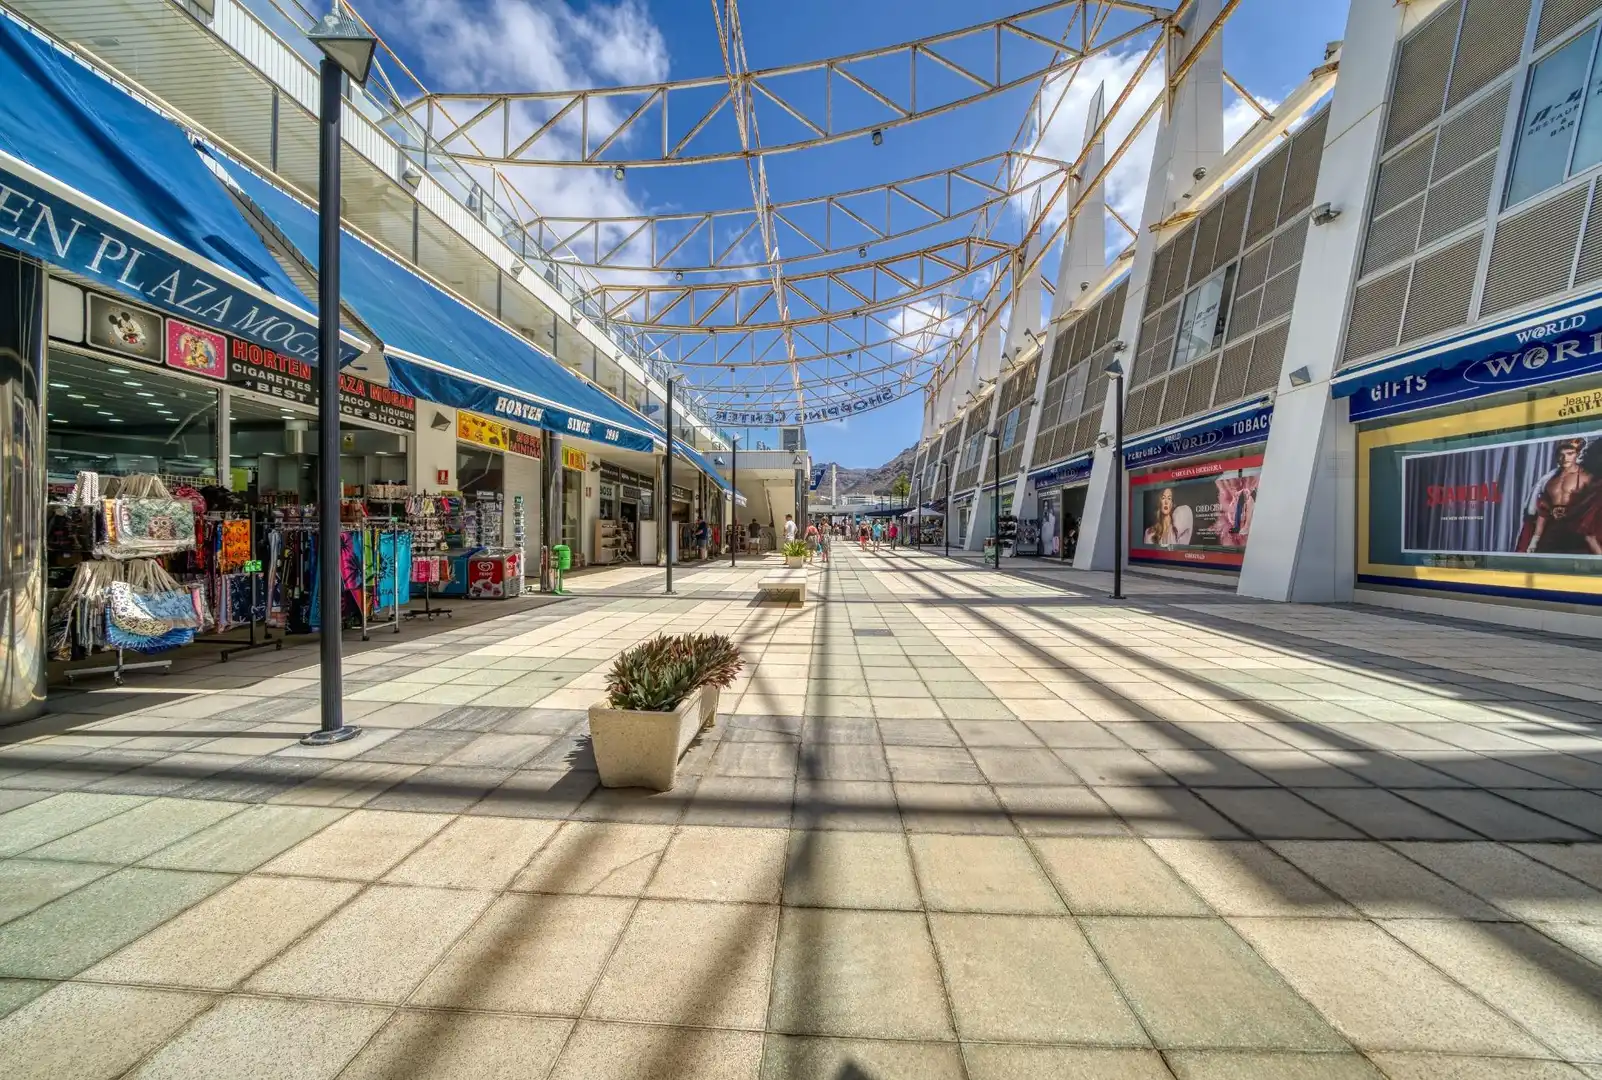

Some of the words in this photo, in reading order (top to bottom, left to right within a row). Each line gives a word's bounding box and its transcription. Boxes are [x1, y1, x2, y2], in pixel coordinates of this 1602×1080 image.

[1550, 120, 1574, 137] BAR
[0, 183, 86, 258] EN
[85, 232, 233, 322] PLAZA
[1516, 314, 1586, 344] WORLD
[232, 338, 311, 380] HORTEN
[338, 373, 365, 397] AZA
[370, 383, 414, 411] MOGAN
[232, 363, 311, 392] CIGARETTES
[338, 393, 371, 408] BACCO
[380, 405, 414, 420] LIQUEUR
[1371, 374, 1428, 401] GIFTS
[257, 382, 307, 402] BEST
[369, 411, 404, 426] SHOP
[495, 396, 544, 421] HORTEN
[567, 417, 591, 434] SINCE
[1172, 432, 1217, 452] WORLD
